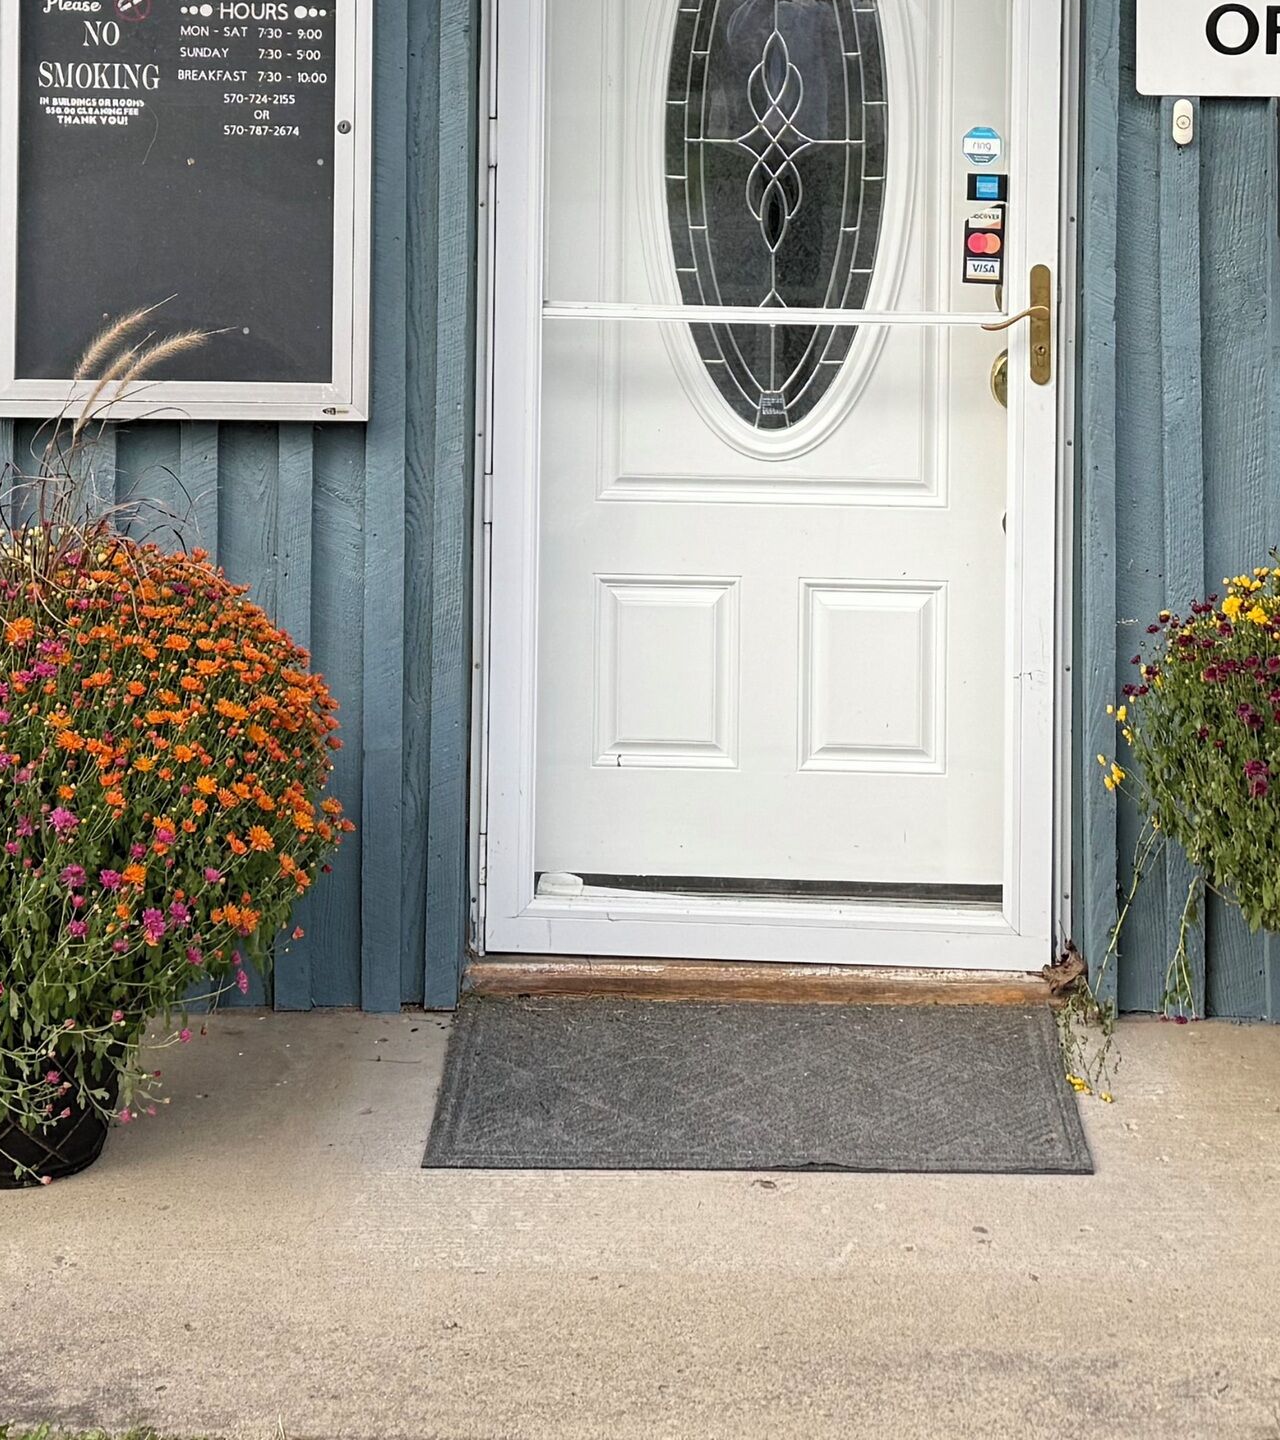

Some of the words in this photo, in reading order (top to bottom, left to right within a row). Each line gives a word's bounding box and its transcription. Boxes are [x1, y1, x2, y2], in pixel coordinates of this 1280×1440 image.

[219, 2, 289, 21] HOURS
[82, 20, 120, 47] NO
[180, 25, 210, 37] MON
[223, 26, 248, 38] SAT
[297, 28, 323, 40] 9:00
[179, 46, 229, 58] SUNDAY
[258, 48, 283, 60] 7:30
[38, 61, 160, 90] SMOKING
[177, 69, 248, 82] BREAKFAST
[297, 72, 327, 84] 10:00
[39, 96, 50, 105] IN
[97, 98, 111, 107] OR
[223, 93, 296, 105] 570-724-2155
[123, 107, 139, 116] FEE
[253, 110, 270, 120] OR
[56, 115, 97, 125] THANK
[99, 116, 128, 126] YOU!
[223, 125, 300, 137] 570-787-2674
[972, 141, 992, 152] ring
[972, 263, 995, 273] VISA
